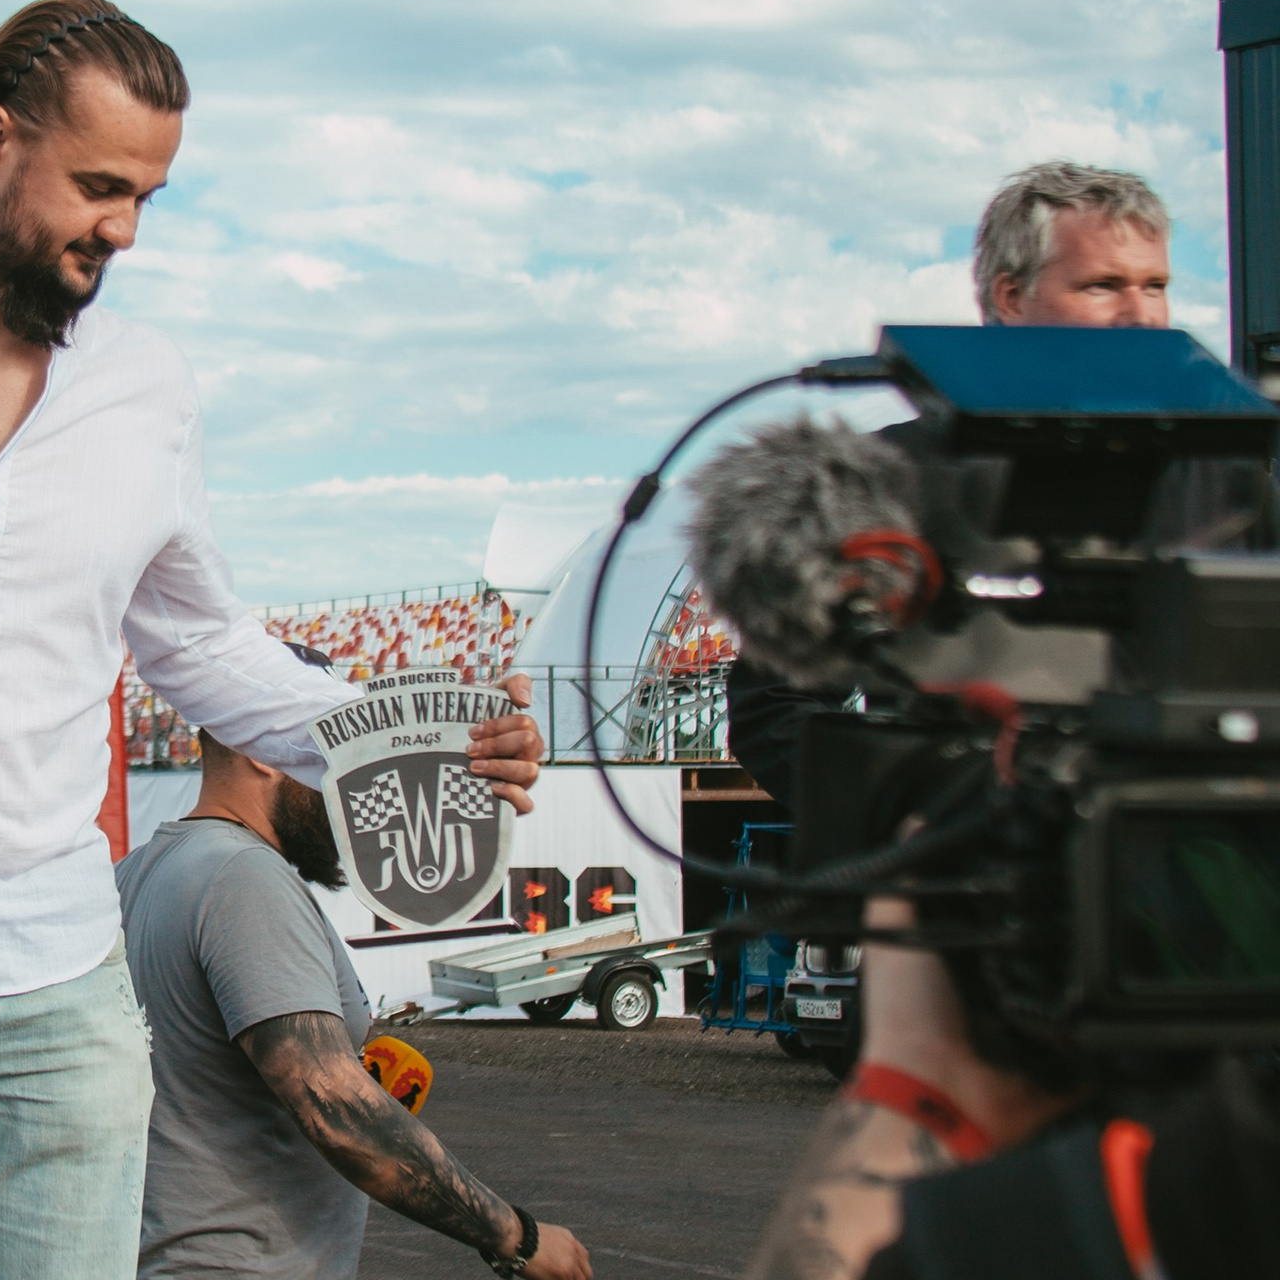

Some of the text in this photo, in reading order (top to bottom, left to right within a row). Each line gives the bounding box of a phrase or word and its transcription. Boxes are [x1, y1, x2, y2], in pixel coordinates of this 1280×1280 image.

[368, 671, 457, 693] MAD BUCKETS
[316, 695, 406, 751] RUSSIAN
[390, 731, 442, 749] DRAGS
